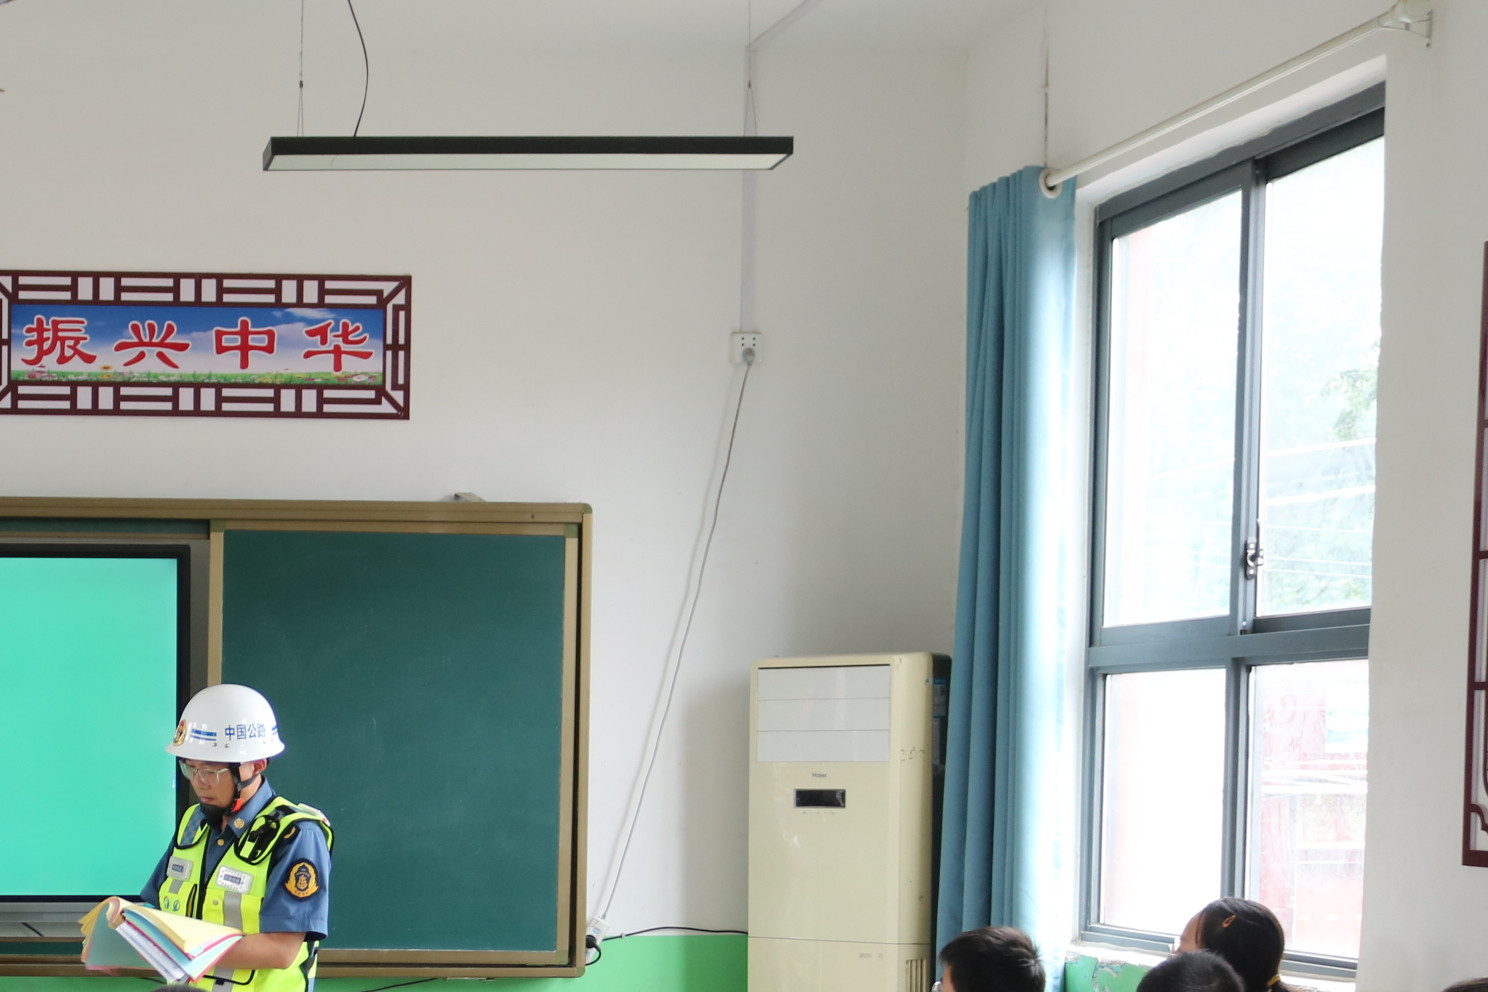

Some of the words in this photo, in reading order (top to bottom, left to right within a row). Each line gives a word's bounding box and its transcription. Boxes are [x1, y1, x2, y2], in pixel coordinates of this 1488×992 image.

[20, 314, 375, 373] 振兴中华
[225, 723, 266, 741] 中国公路
